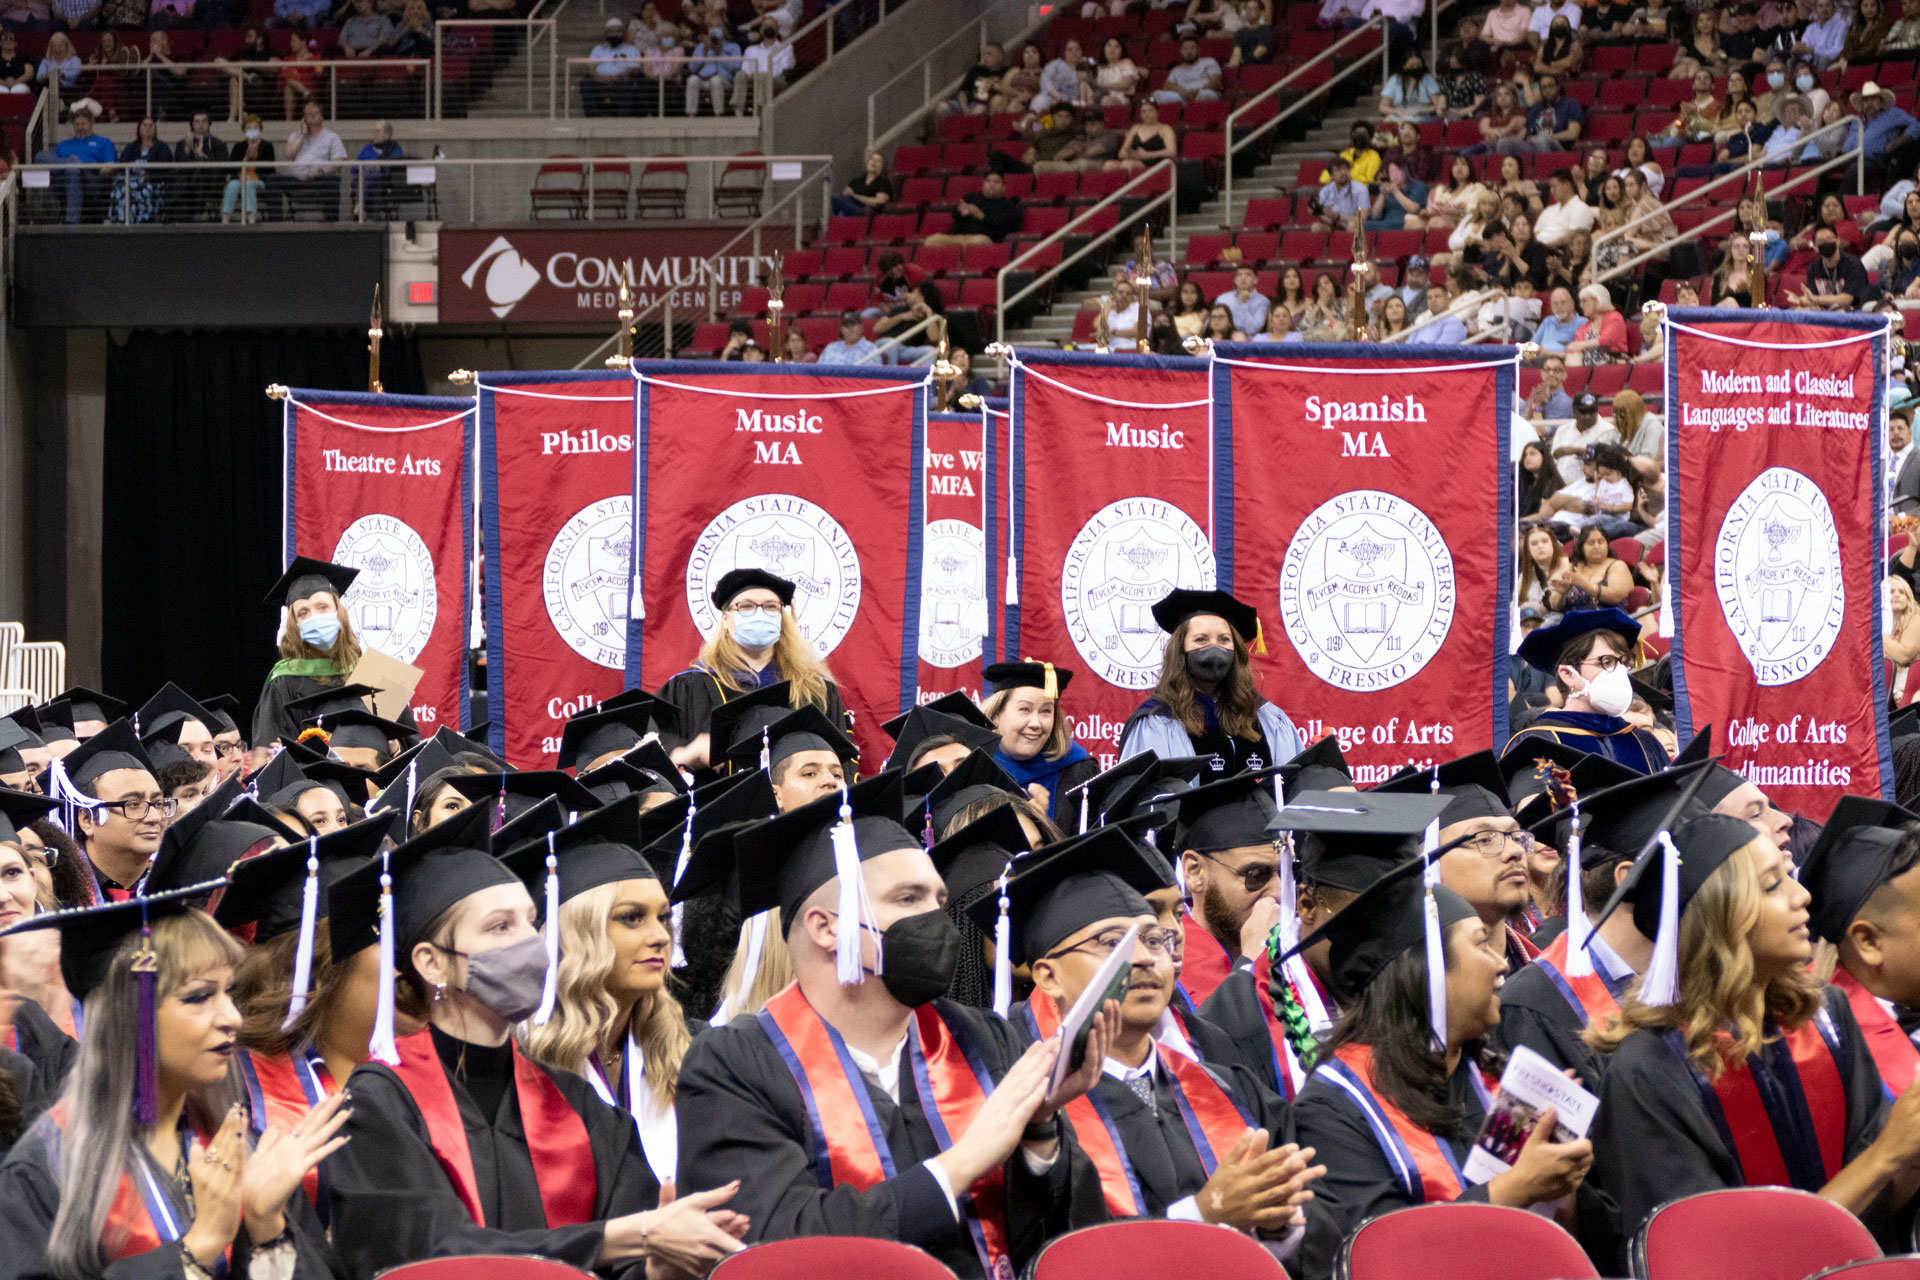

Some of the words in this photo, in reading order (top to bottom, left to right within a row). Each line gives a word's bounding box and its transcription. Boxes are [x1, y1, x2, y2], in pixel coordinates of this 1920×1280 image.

[577, 292, 660, 308] MEDCAL
[670, 291, 742, 307] CENER
[1701, 369, 1763, 394] Modern
[1766, 369, 1791, 393] and
[1795, 370, 1855, 398] Classical
[735, 408, 823, 434] Music
[1305, 395, 1427, 430] Spanish
[1683, 402, 1765, 432] Languages
[1768, 400, 1791, 425] and
[1795, 402, 1870, 431] Literatures
[541, 428, 633, 455] Philos
[1105, 422, 1184, 449] Music
[1341, 432, 1391, 457] MA
[322, 448, 396, 474] Theatre
[400, 453, 441, 476] Arts
[753, 440, 803, 465] MA
[930, 475, 975, 497] MFA
[930, 523, 972, 539] STATE
[546, 518, 588, 632] CALIFORNIA
[596, 500, 632, 517] STA
[690, 514, 736, 631] CALIFORNIA
[745, 498, 808, 516] STATE
[817, 516, 858, 636] UNIVERSITY
[1719, 494, 1757, 636] CALIFORNIA
[1761, 472, 1803, 492] STATE
[359, 518, 401, 536] STATE
[407, 534, 435, 640] UNIVERSITY
[606, 576, 628, 586] ACCIP
[1065, 519, 1106, 643] CALIFORNIA
[1114, 501, 1171, 521] STATE
[1284, 515, 1327, 645] CALIFORNIA
[1335, 494, 1398, 515] STATE
[1408, 512, 1452, 645] UNIVERSITY
[1315, 582, 1339, 601] LVCEM
[1342, 583, 1370, 595] ACCIPE
[1387, 581, 1418, 602] REDDAS
[928, 647, 972, 665] RESNO
[1326, 636, 1343, 651] 19
[1387, 636, 1402, 651] 11
[1105, 664, 1161, 686] FRESN
[1328, 663, 1406, 687] FRESNO
[1760, 656, 1808, 682] ESNO
[413, 704, 436, 722] rts
[547, 695, 594, 719] Coll
[1298, 720, 1366, 752] ollege
[1372, 717, 1399, 744] of
[1403, 720, 1454, 744] Arts
[1775, 714, 1801, 744] of
[1803, 717, 1847, 744] Arts
[130, 950, 158, 971] 22
